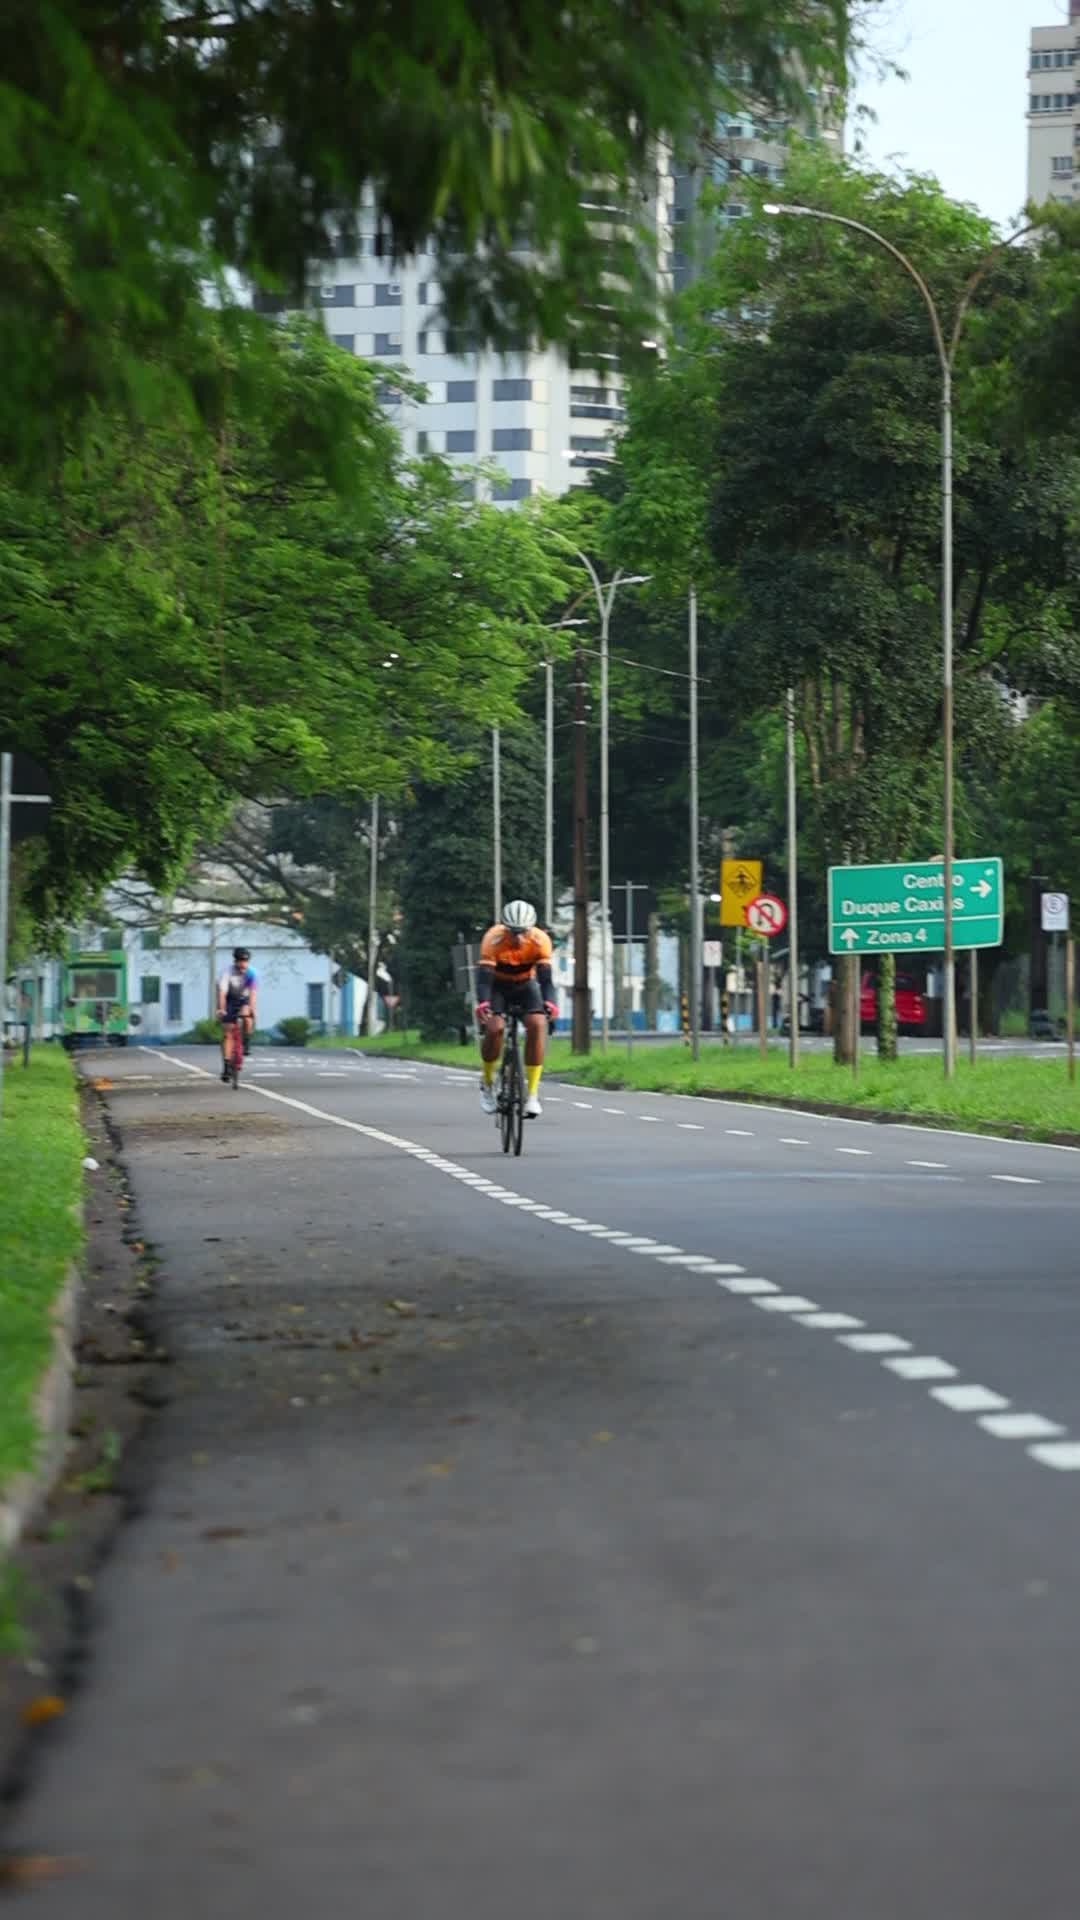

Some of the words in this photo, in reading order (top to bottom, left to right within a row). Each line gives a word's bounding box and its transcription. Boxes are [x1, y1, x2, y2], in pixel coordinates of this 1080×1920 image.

[903, 873, 964, 889] Cento
[841, 900, 900, 917] Duque
[904, 896, 965, 912] Caxis
[866, 929, 913, 945] Zona
[915, 928, 928, 942] 4
